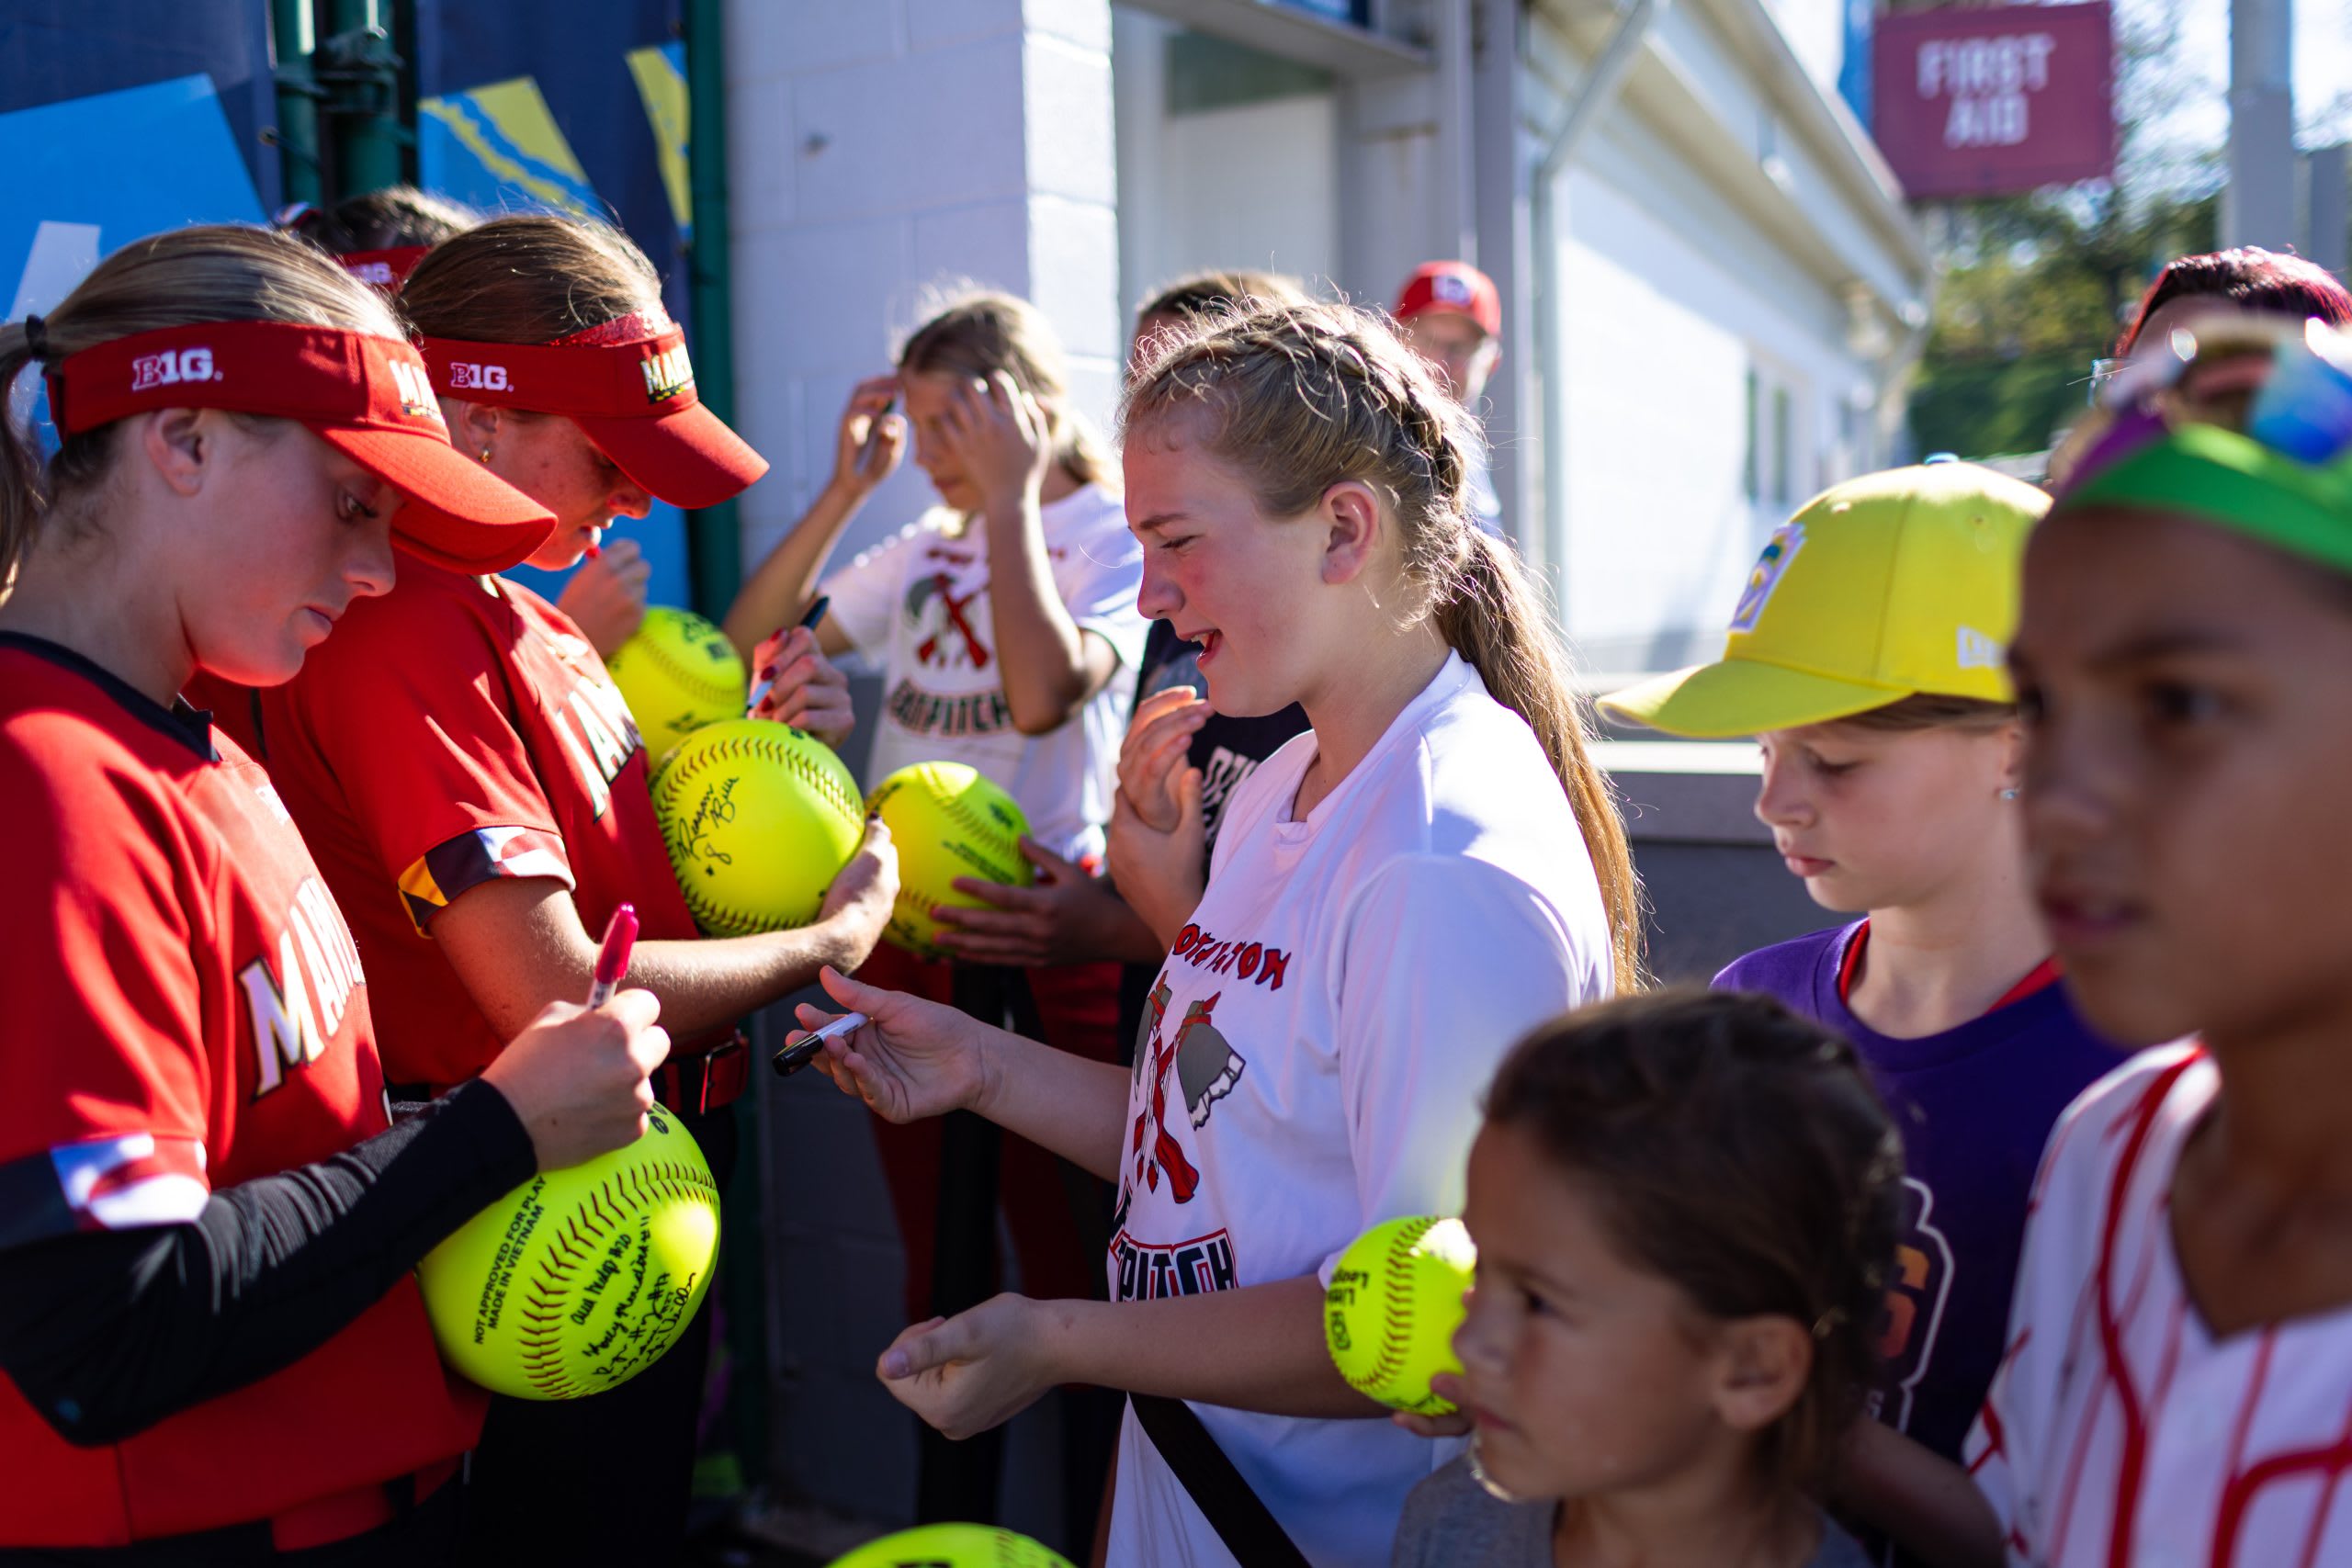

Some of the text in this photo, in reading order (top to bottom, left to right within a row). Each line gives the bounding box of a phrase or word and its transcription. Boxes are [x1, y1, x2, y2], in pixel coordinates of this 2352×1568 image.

[1917, 33, 2056, 99] FIRST
[1943, 94, 2029, 147] AID
[474, 1175, 547, 1345] NOT APPROVED FOR PLAY
[488, 1204, 545, 1329] MADE IN VIETNAM
